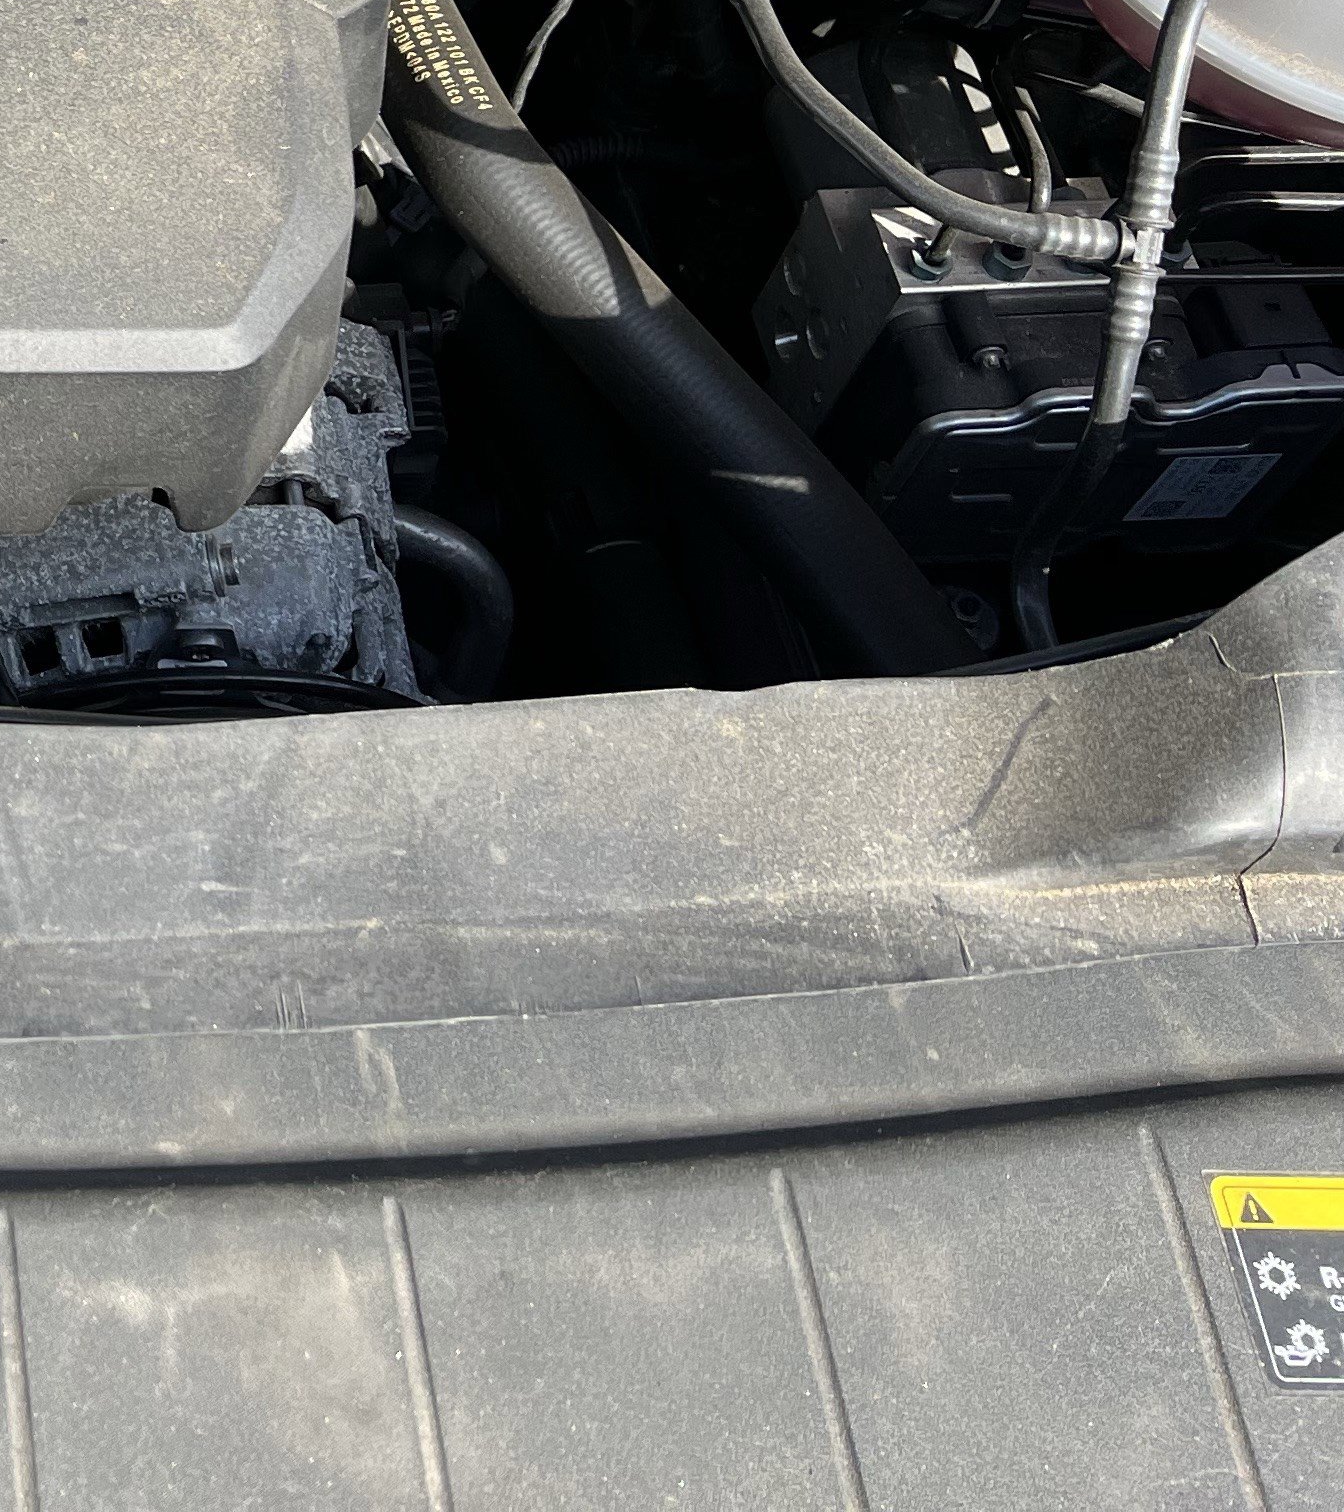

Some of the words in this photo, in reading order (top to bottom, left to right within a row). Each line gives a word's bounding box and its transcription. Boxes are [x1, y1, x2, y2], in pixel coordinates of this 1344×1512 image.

[407, 14, 433, 46] Made
[424, 46, 441, 60] in
[434, 22, 457, 43] 122
[446, 45, 469, 65] 101
[458, 68, 480, 84] BK
[432, 59, 464, 104] Mexico
